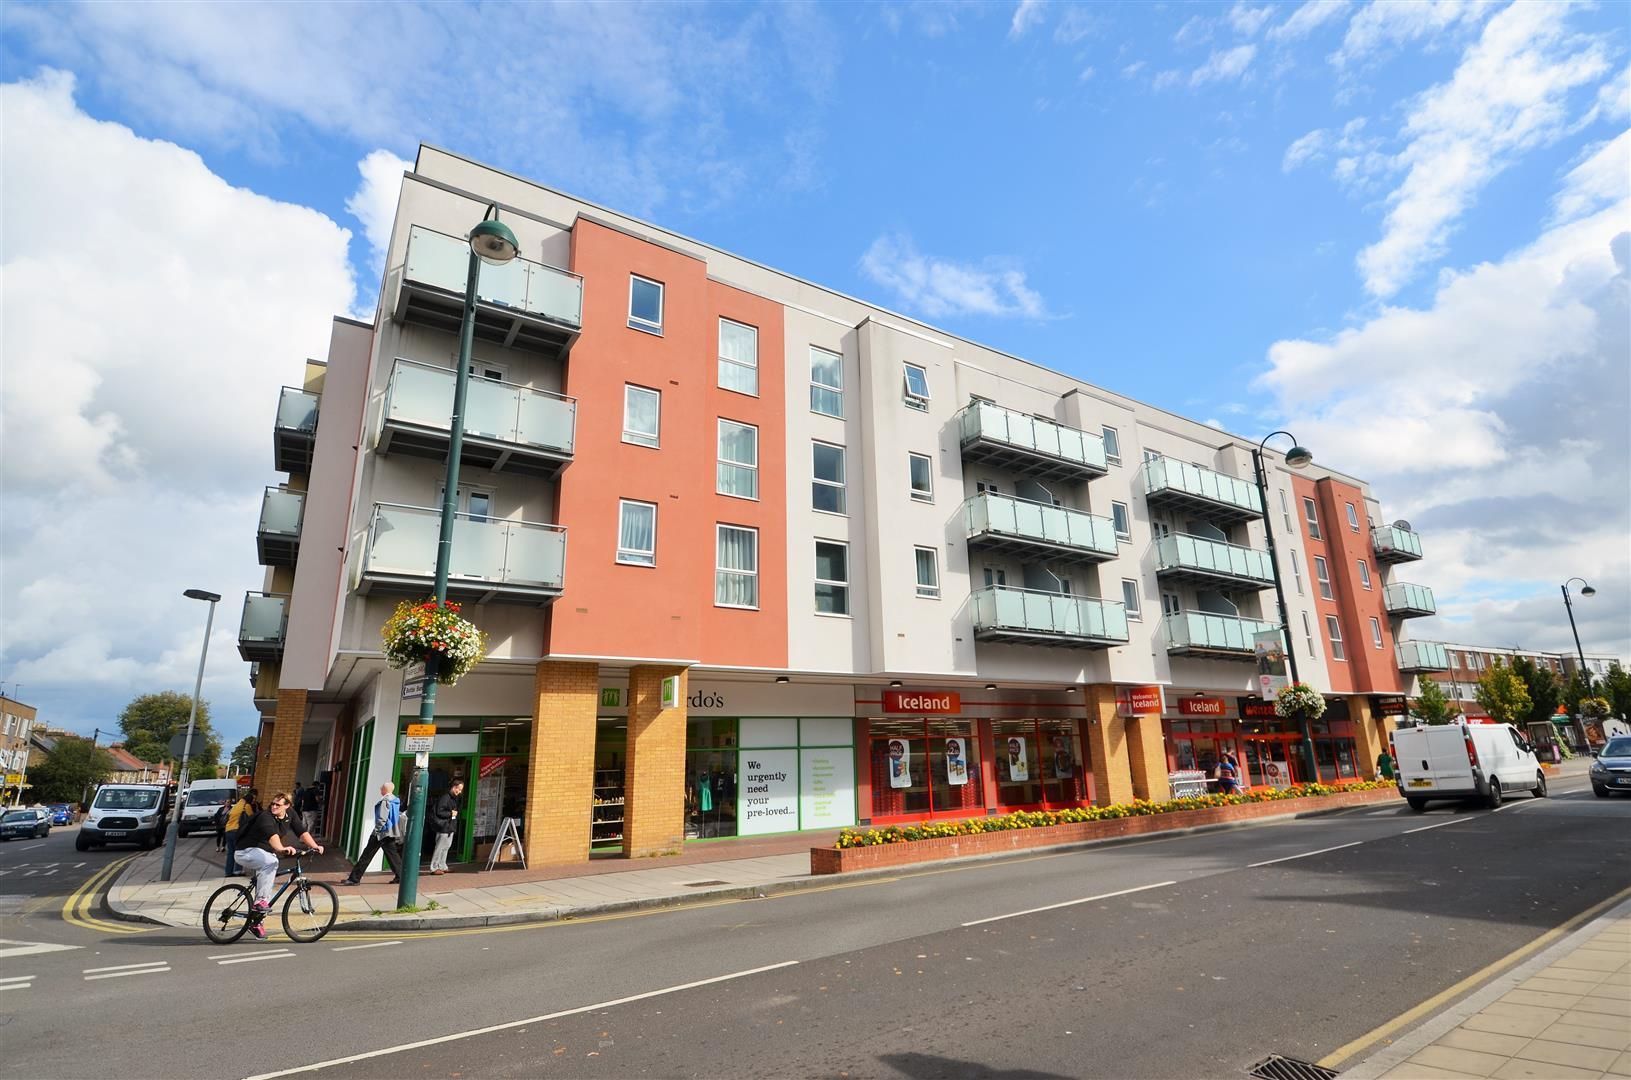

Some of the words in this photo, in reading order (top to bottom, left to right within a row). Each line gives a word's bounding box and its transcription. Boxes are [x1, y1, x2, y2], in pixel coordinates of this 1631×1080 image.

[686, 690, 725, 709] rdo's
[898, 695, 951, 710] Iceland
[1133, 699, 1160, 709] Iceland
[1189, 701, 1220, 714] Iceland
[747, 761, 761, 770] We
[747, 771, 787, 784] urgently
[747, 784, 769, 794] need
[747, 796, 770, 807] your
[747, 806, 796, 820] pre-loved...
